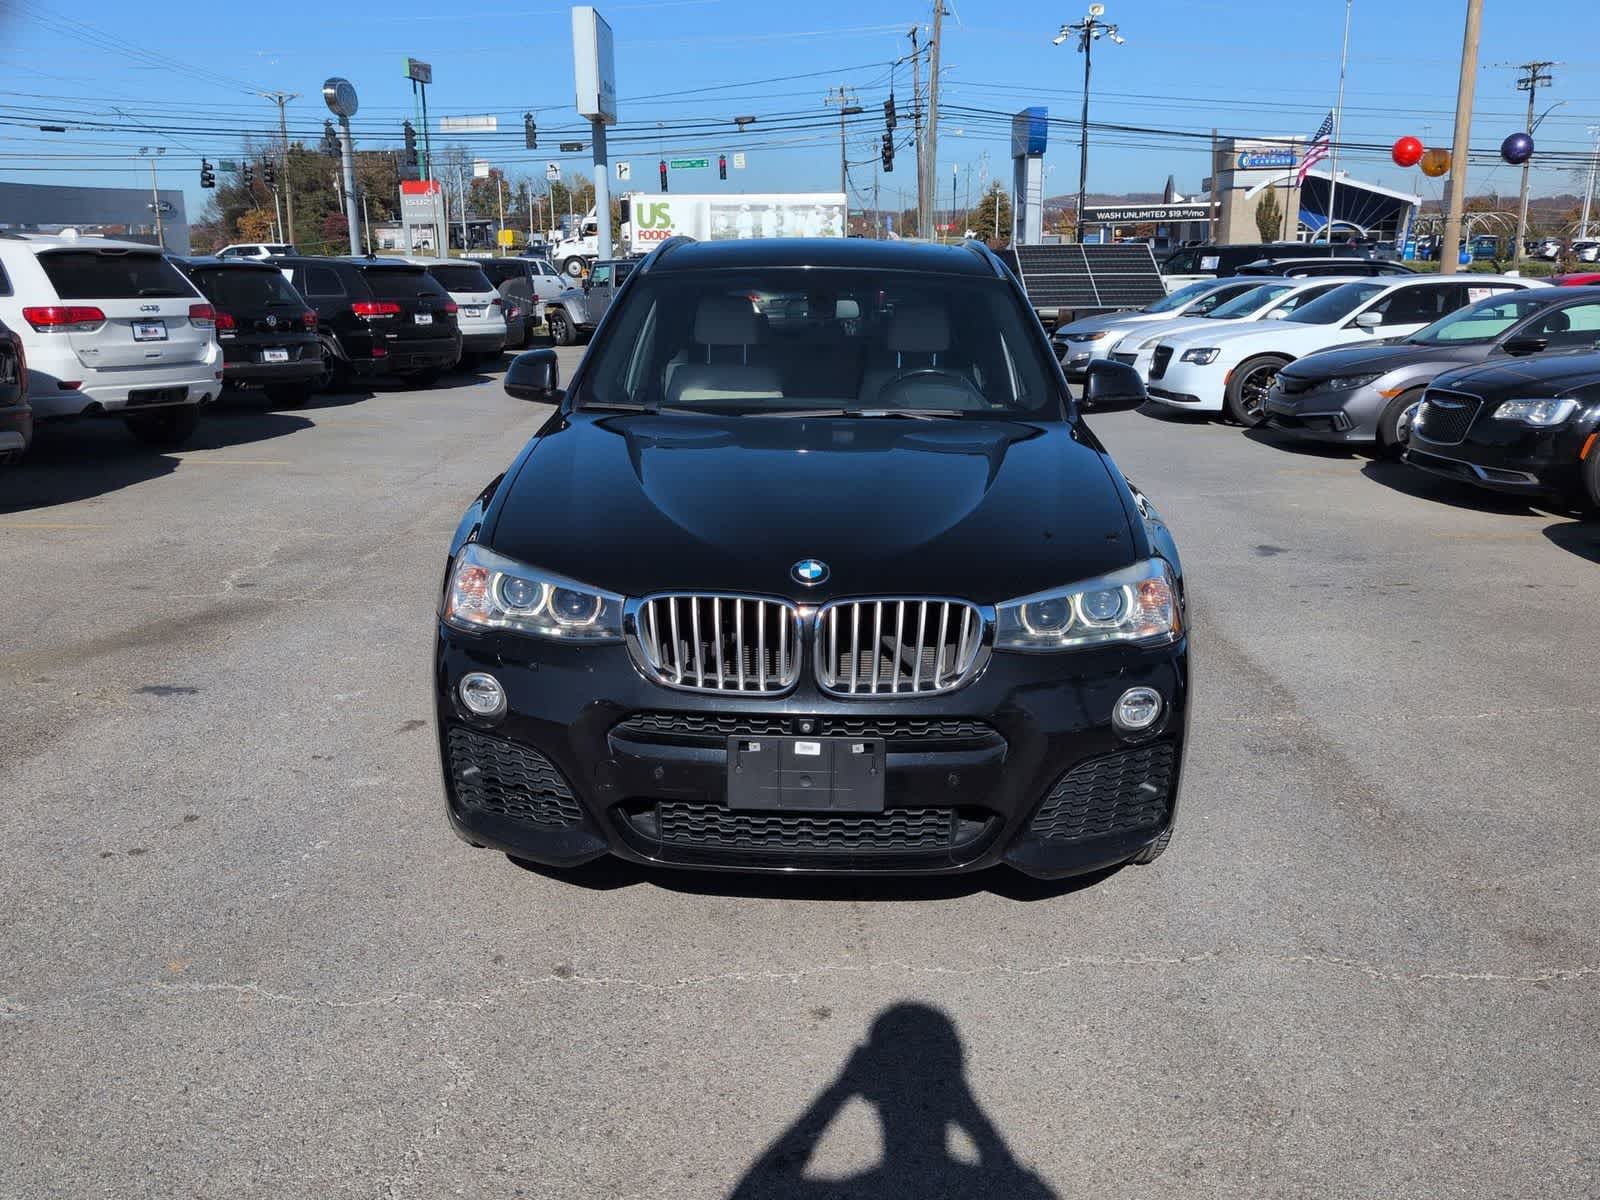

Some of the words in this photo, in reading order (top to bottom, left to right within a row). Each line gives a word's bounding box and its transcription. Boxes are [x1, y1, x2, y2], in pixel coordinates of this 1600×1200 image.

[1096, 211, 1121, 220] WASH
[1122, 210, 1167, 219] UNLIMITED
[638, 230, 673, 241] FOODS
